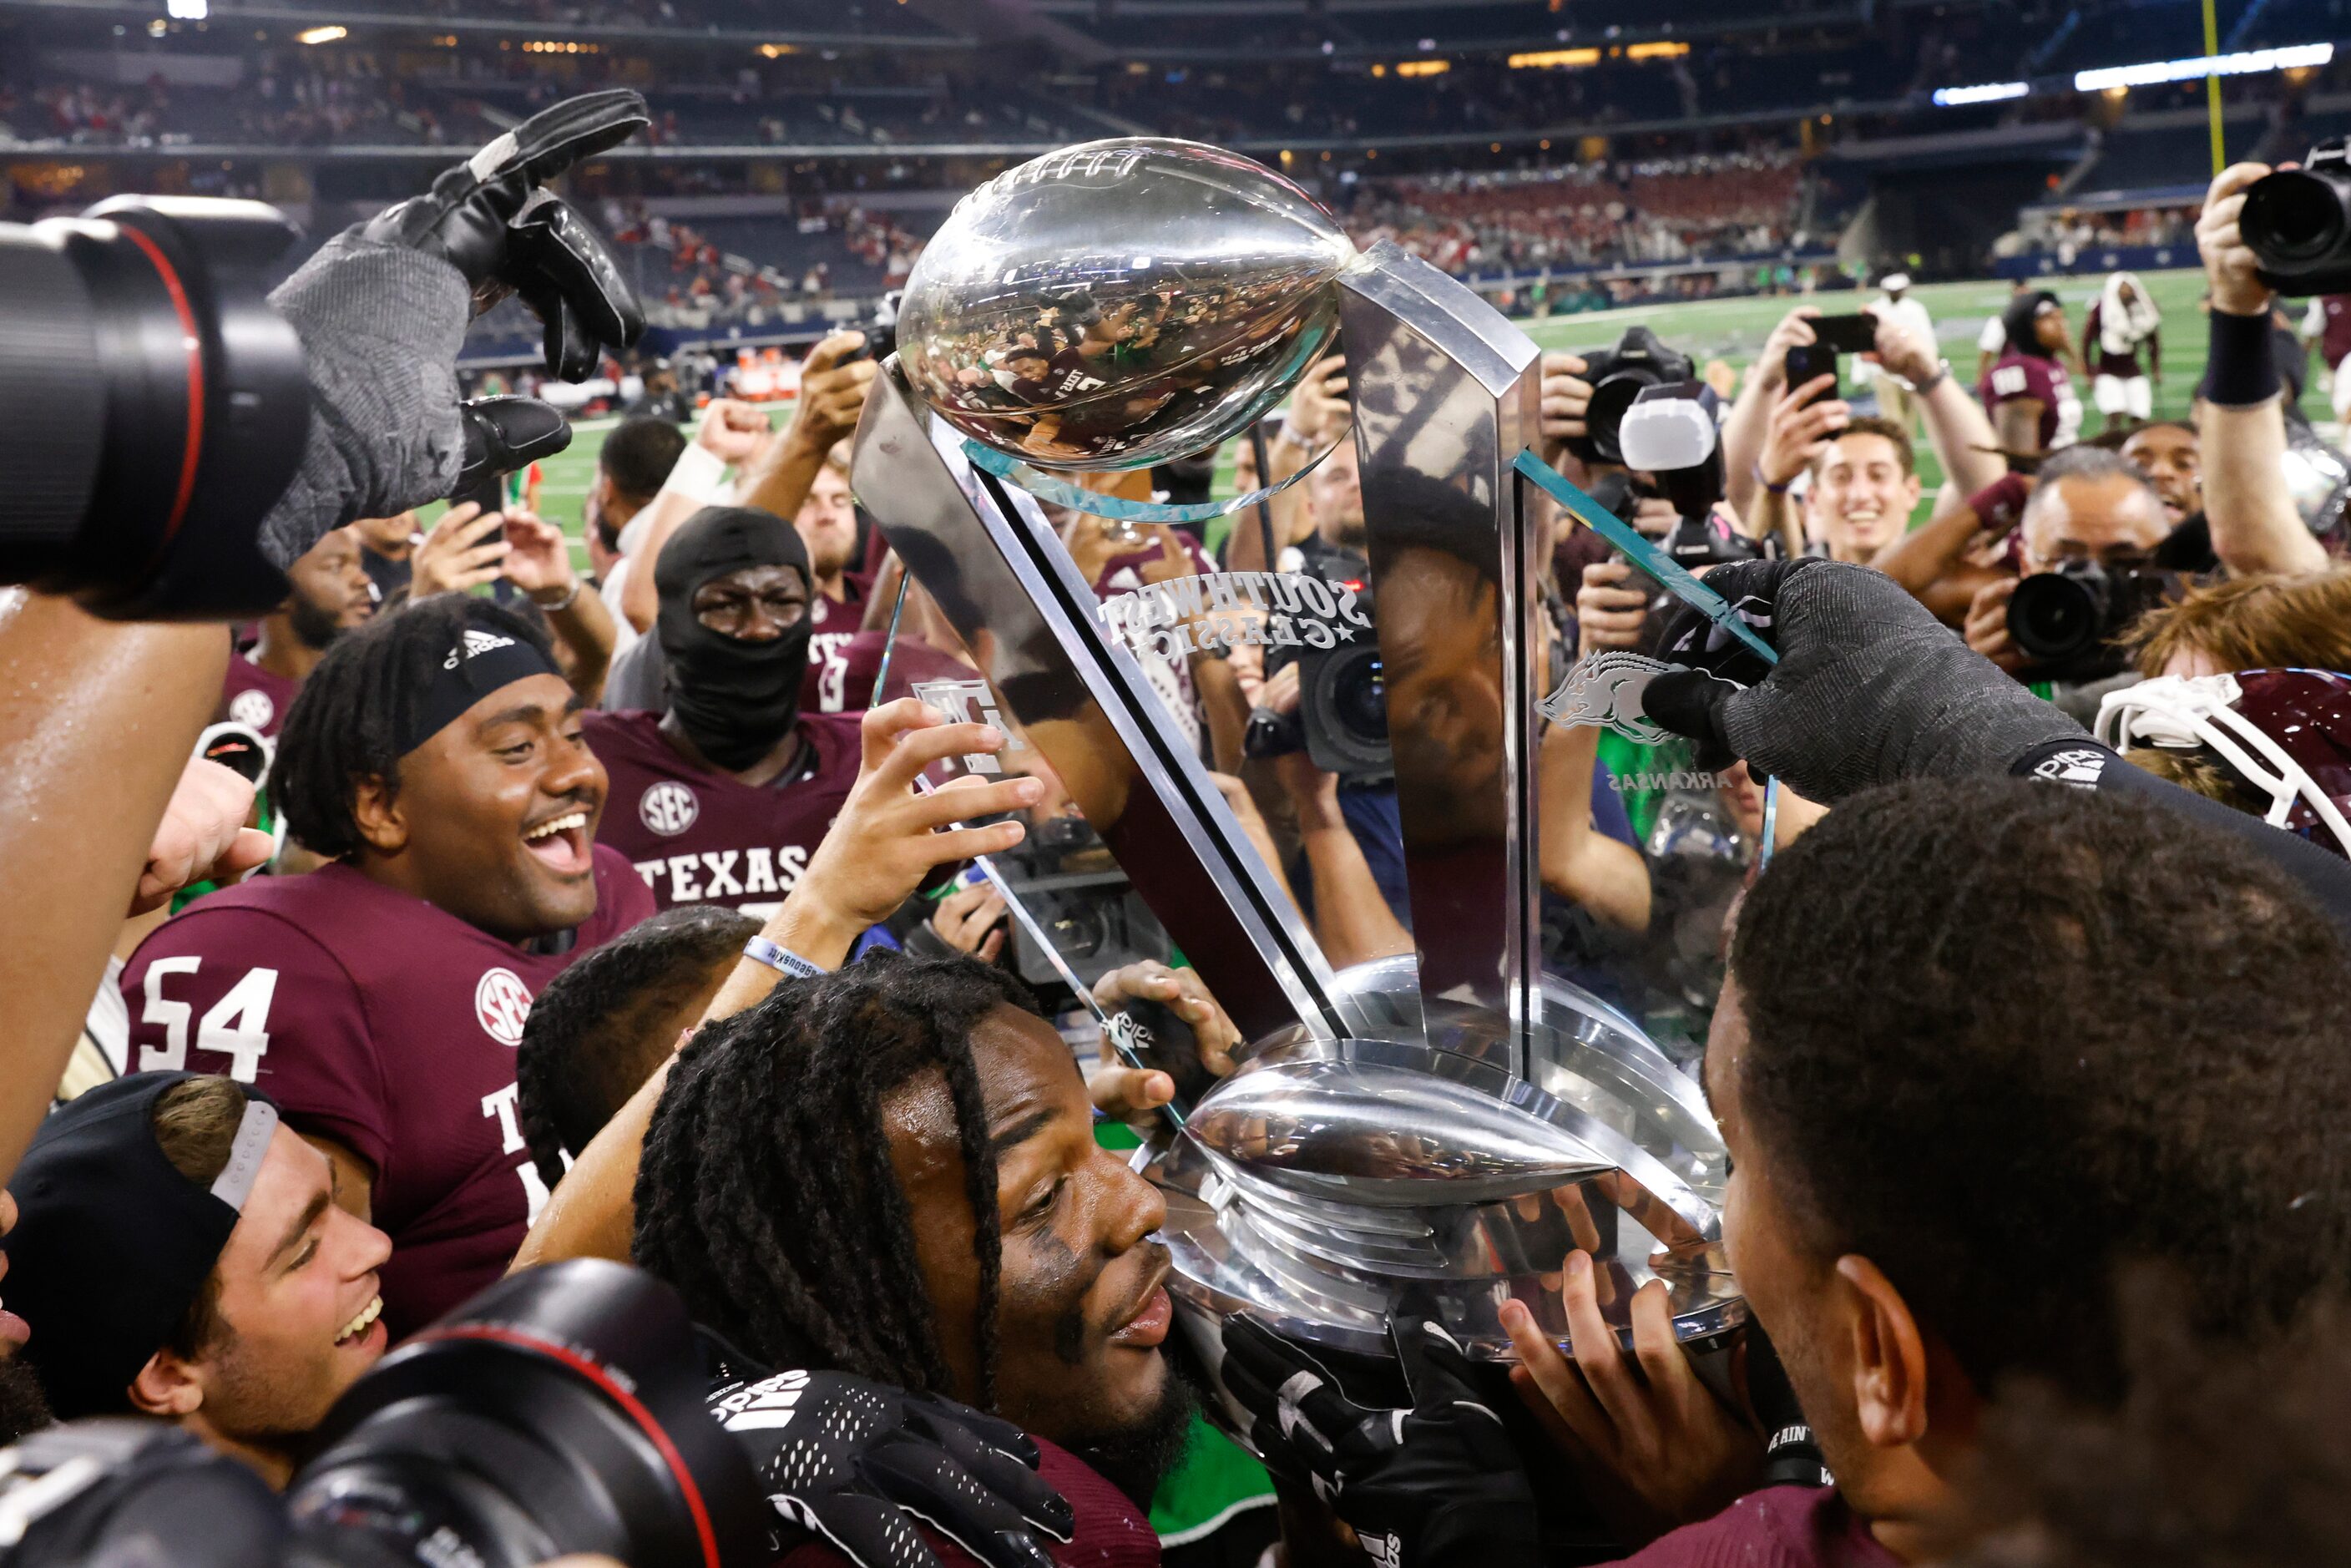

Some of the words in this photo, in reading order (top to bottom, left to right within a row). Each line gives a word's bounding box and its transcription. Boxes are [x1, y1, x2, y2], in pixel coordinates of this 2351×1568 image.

[2029, 750, 2105, 781] adid
[645, 785, 693, 831] SEC
[633, 845, 806, 902] TEXAS
[139, 956, 279, 1084] 54
